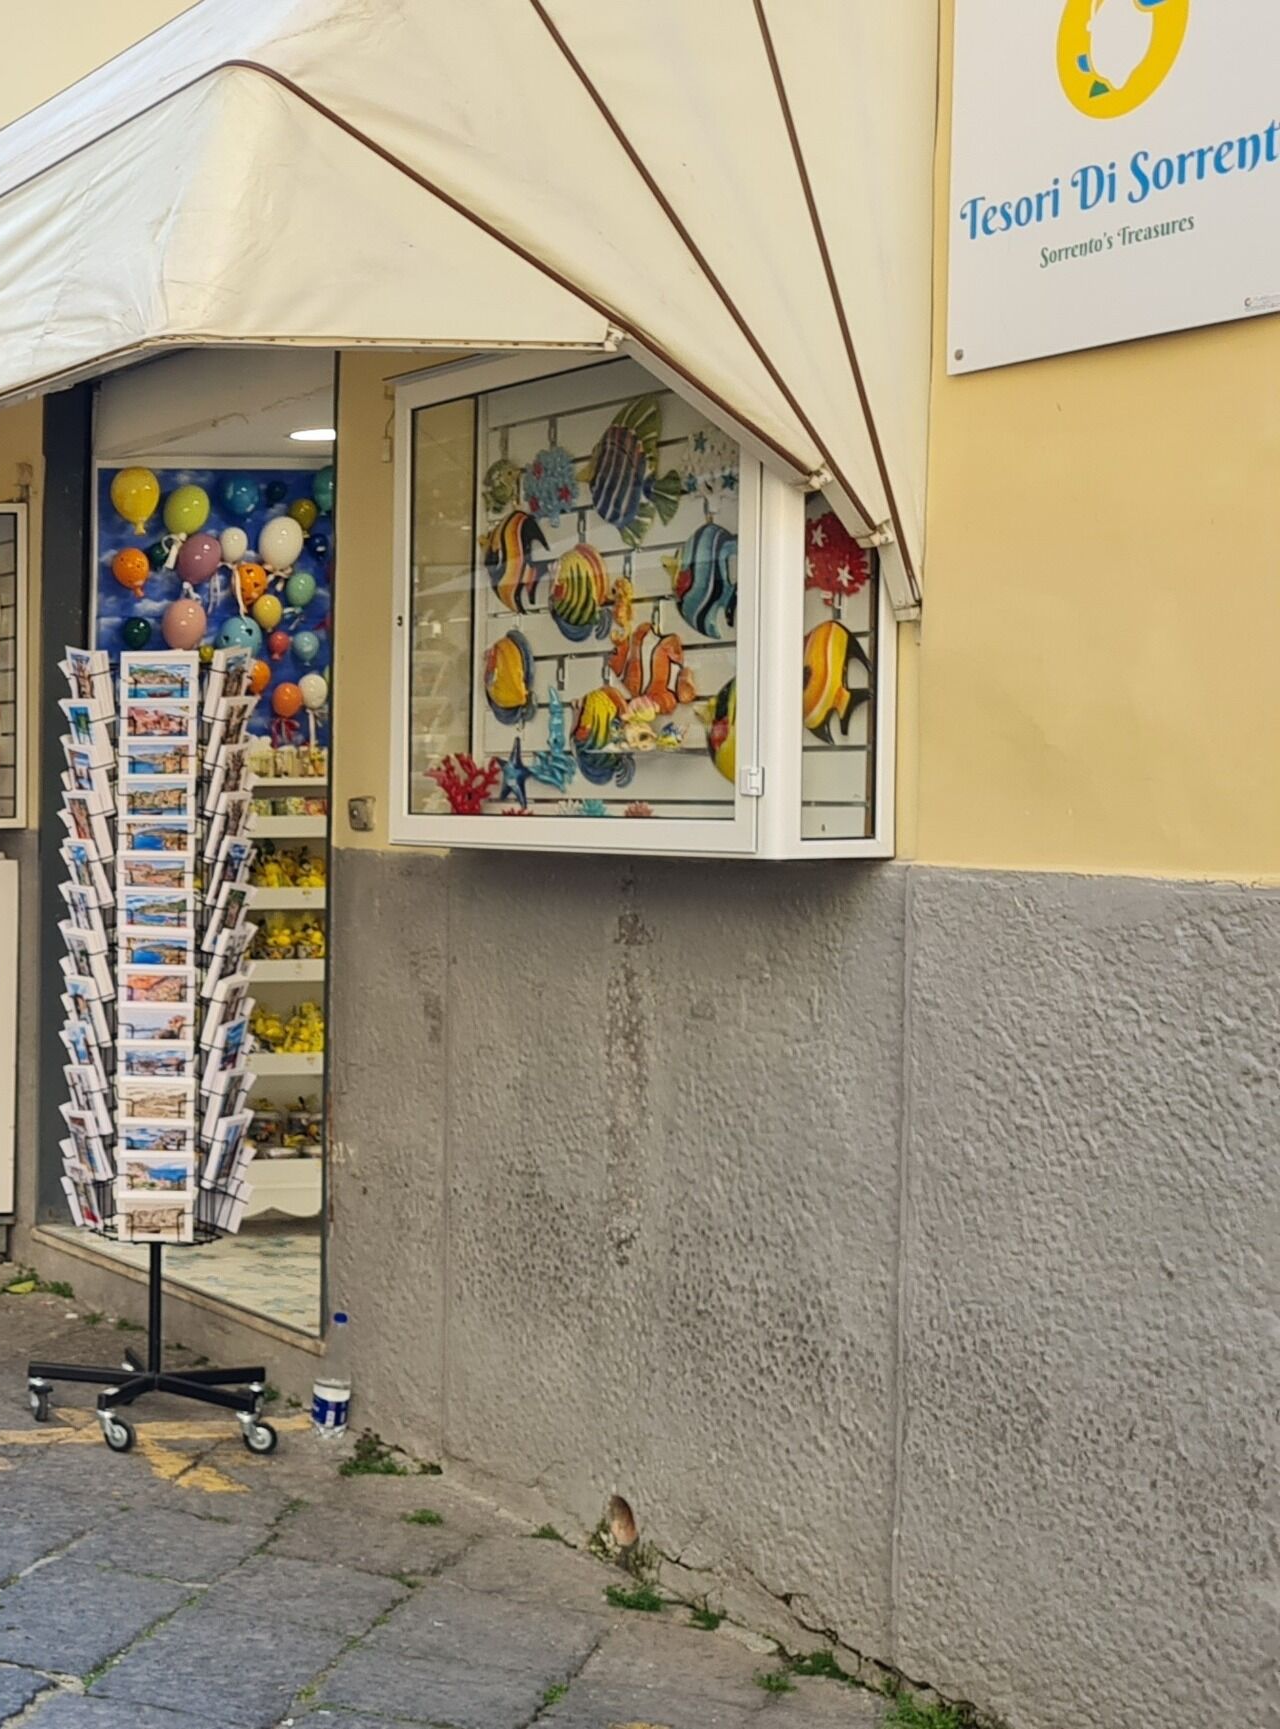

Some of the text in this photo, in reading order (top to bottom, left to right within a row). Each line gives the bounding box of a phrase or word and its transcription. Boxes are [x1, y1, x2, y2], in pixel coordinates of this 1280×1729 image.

[959, 118, 1280, 241] Tesori Di Sorrent
[1039, 215, 1195, 269] Sorrento's Treasures
